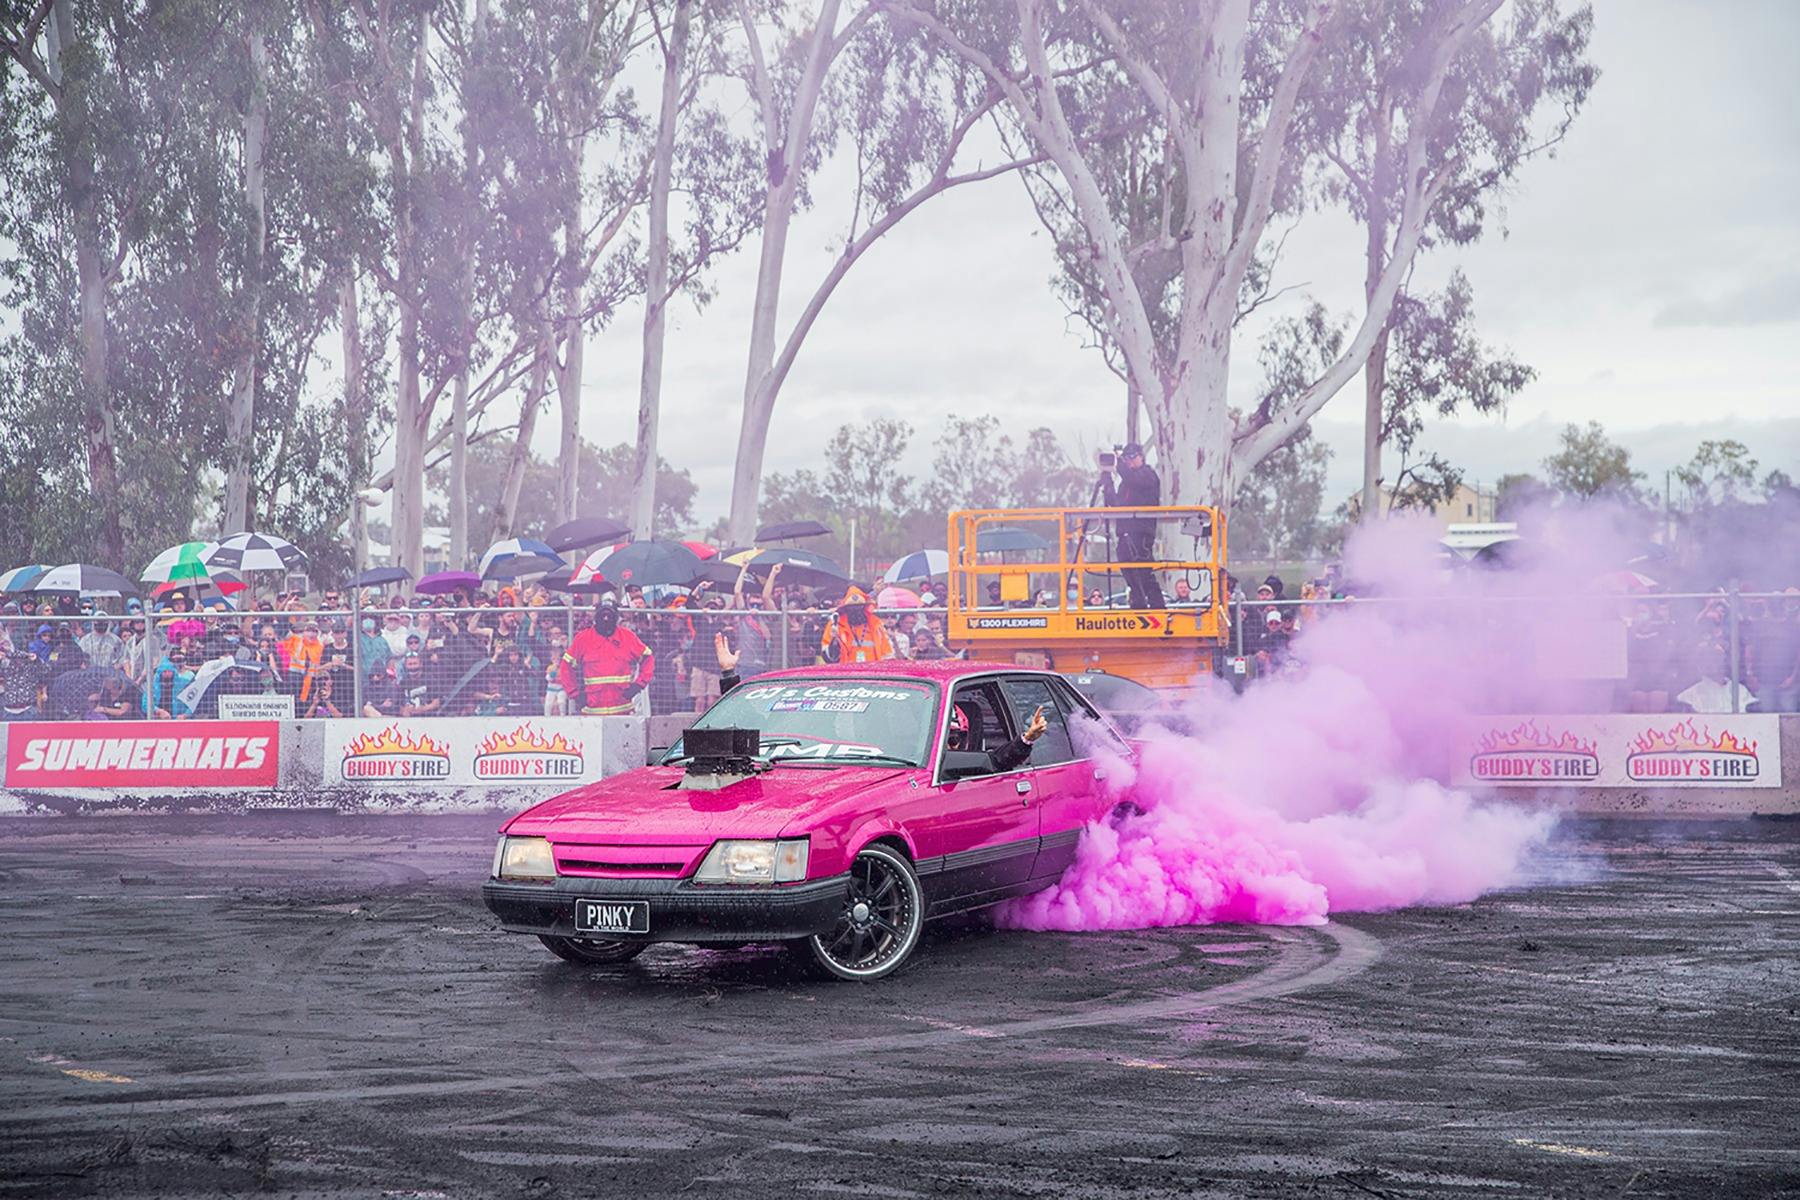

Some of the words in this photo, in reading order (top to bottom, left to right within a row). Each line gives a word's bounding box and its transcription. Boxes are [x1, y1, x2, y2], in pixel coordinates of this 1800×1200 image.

[980, 619, 1001, 628] 1300
[1076, 616, 1136, 630] Haulotte
[803, 686, 911, 701] Customs
[16, 737, 269, 771] SUMMERNATS
[587, 905, 635, 927] PINKY
